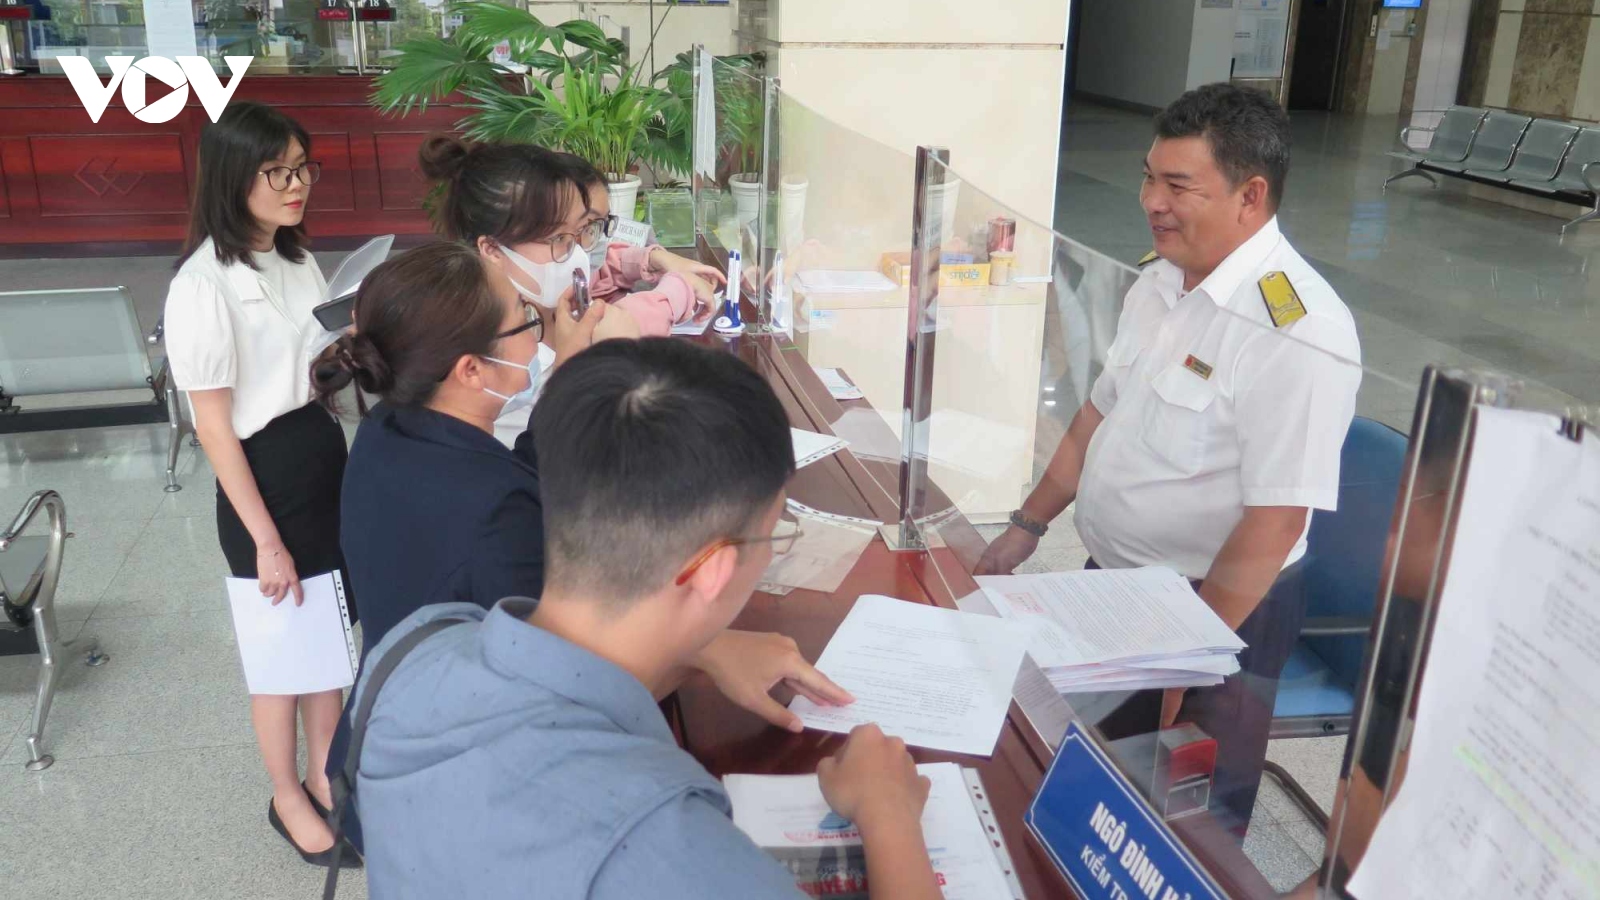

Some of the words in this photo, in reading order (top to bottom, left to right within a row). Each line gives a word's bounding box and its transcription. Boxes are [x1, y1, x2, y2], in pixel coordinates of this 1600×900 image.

[1080, 844, 1111, 889] KIỂM
[1089, 801, 1127, 853] NGÔ
[1120, 838, 1165, 900] ĐÌNH
